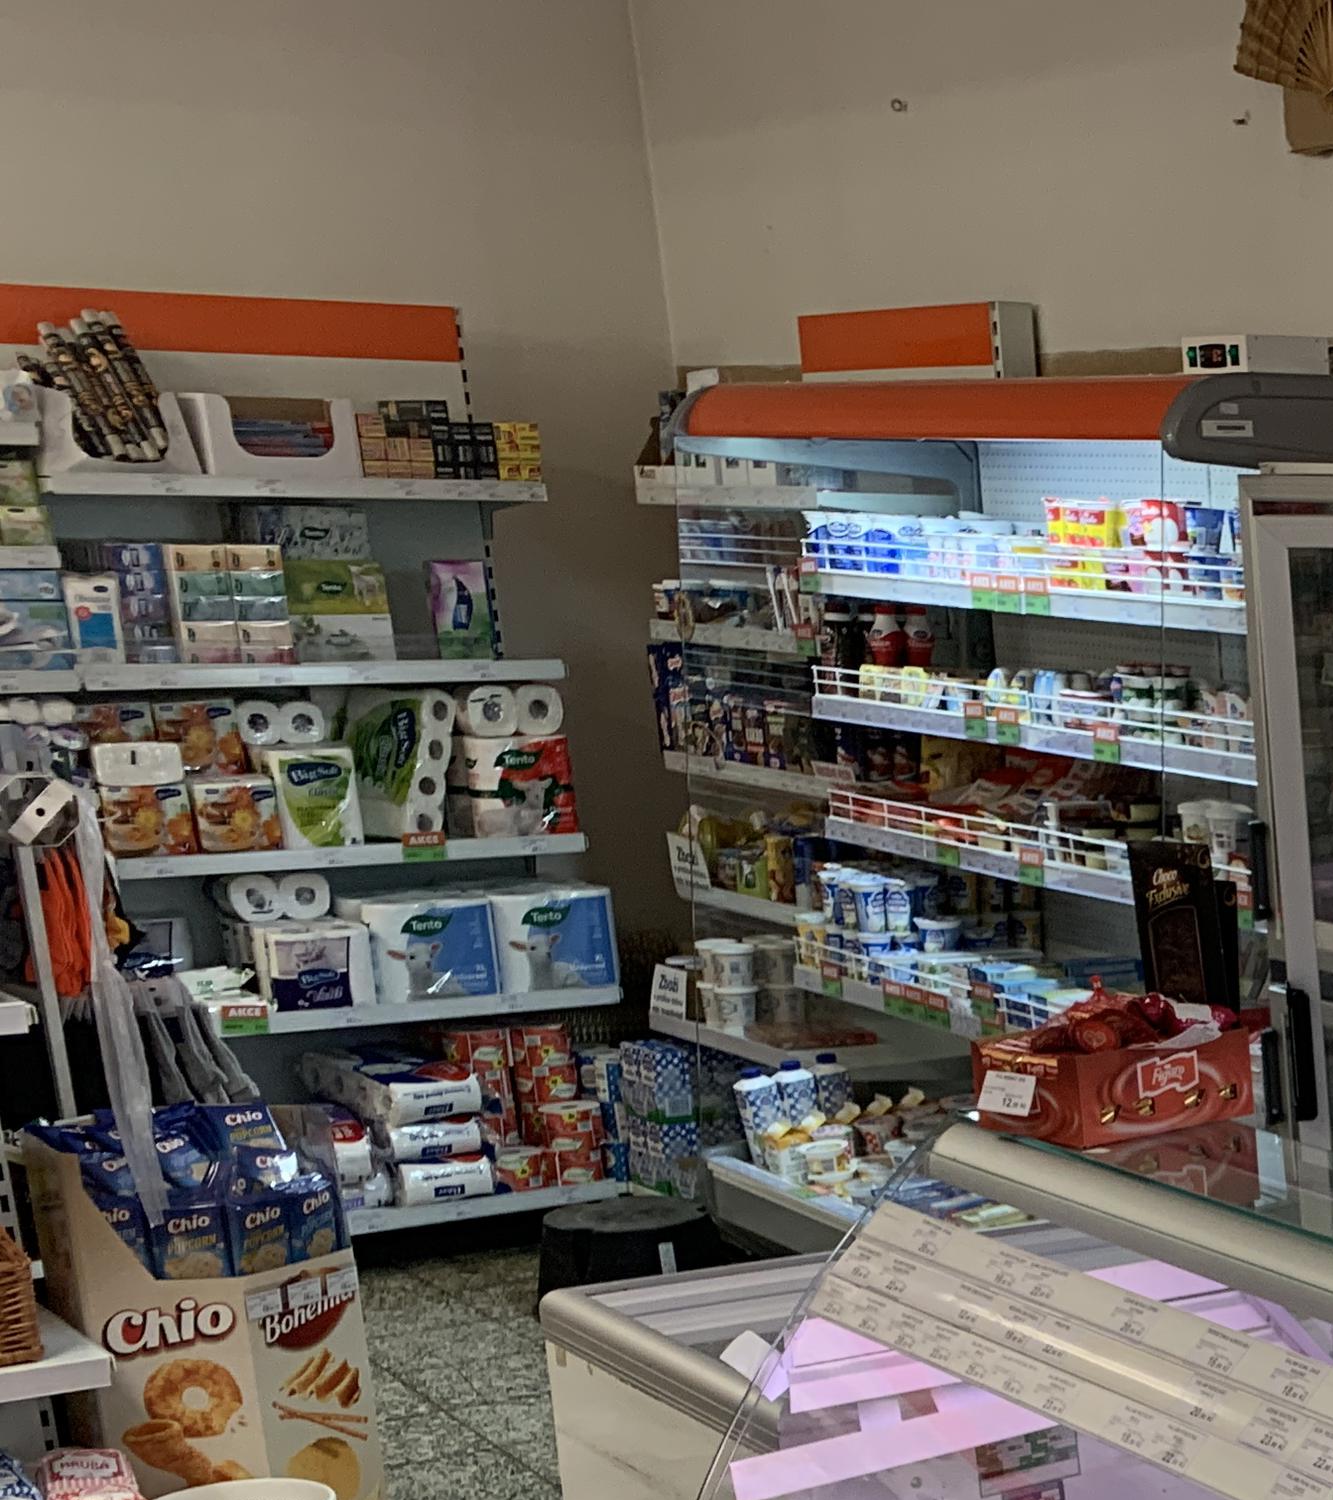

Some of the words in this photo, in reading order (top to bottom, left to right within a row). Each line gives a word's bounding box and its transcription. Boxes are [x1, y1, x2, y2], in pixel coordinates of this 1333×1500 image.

[503, 754, 535, 765] Tento
[410, 835, 439, 845] AKCE
[1152, 868, 1180, 886] Choco
[410, 918, 443, 931] Tento
[531, 911, 561, 923] Tento
[228, 1006, 262, 1018] AKCE
[1152, 1062, 1185, 1085] Figaro
[225, 1111, 262, 1126] Chio
[303, 1191, 330, 1214] Chio
[167, 1215, 209, 1233] Chio
[245, 1207, 280, 1228] Chio
[106, 1298, 233, 1354] Chio
